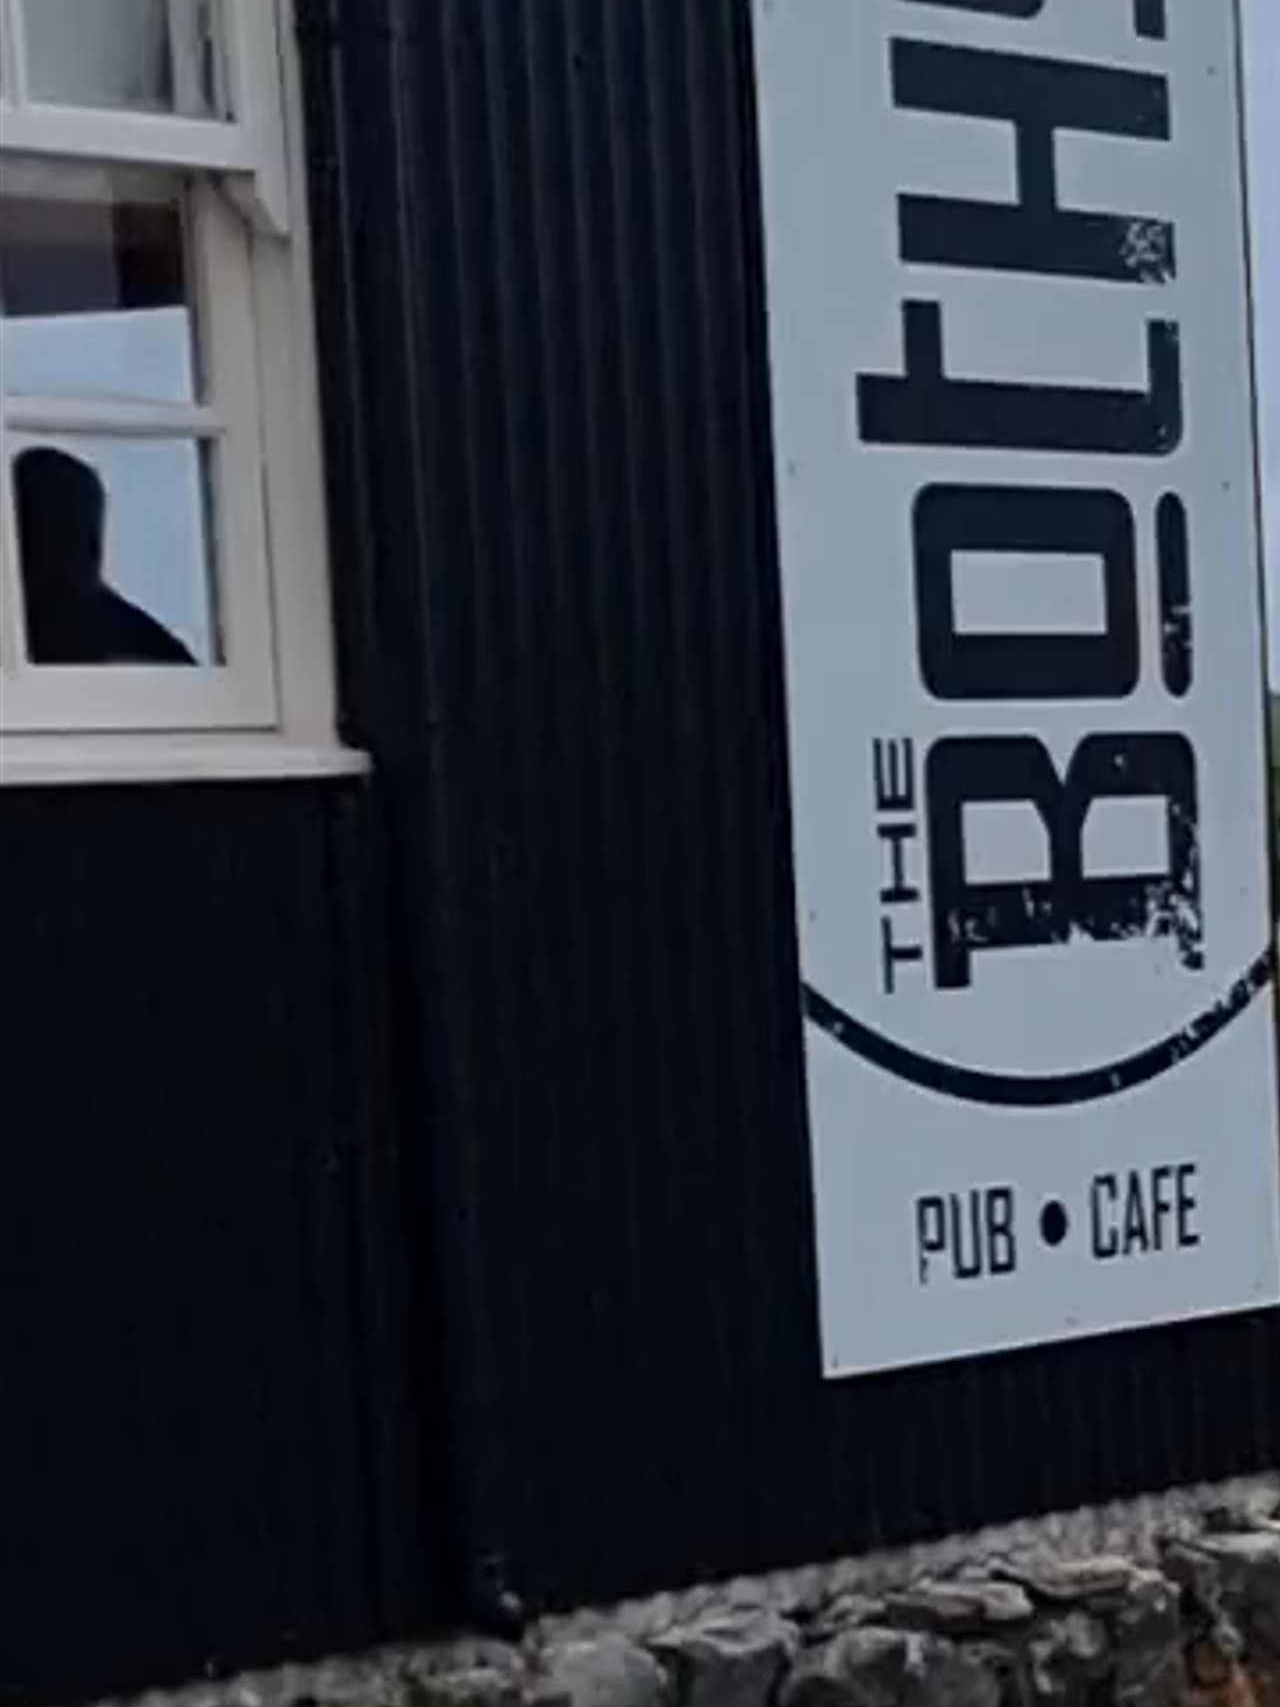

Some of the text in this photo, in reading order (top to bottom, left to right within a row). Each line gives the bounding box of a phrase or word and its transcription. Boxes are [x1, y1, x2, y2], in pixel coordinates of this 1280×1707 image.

[873, 736, 924, 994] THE
[916, 1161, 1201, 1285] PUB CAFE
